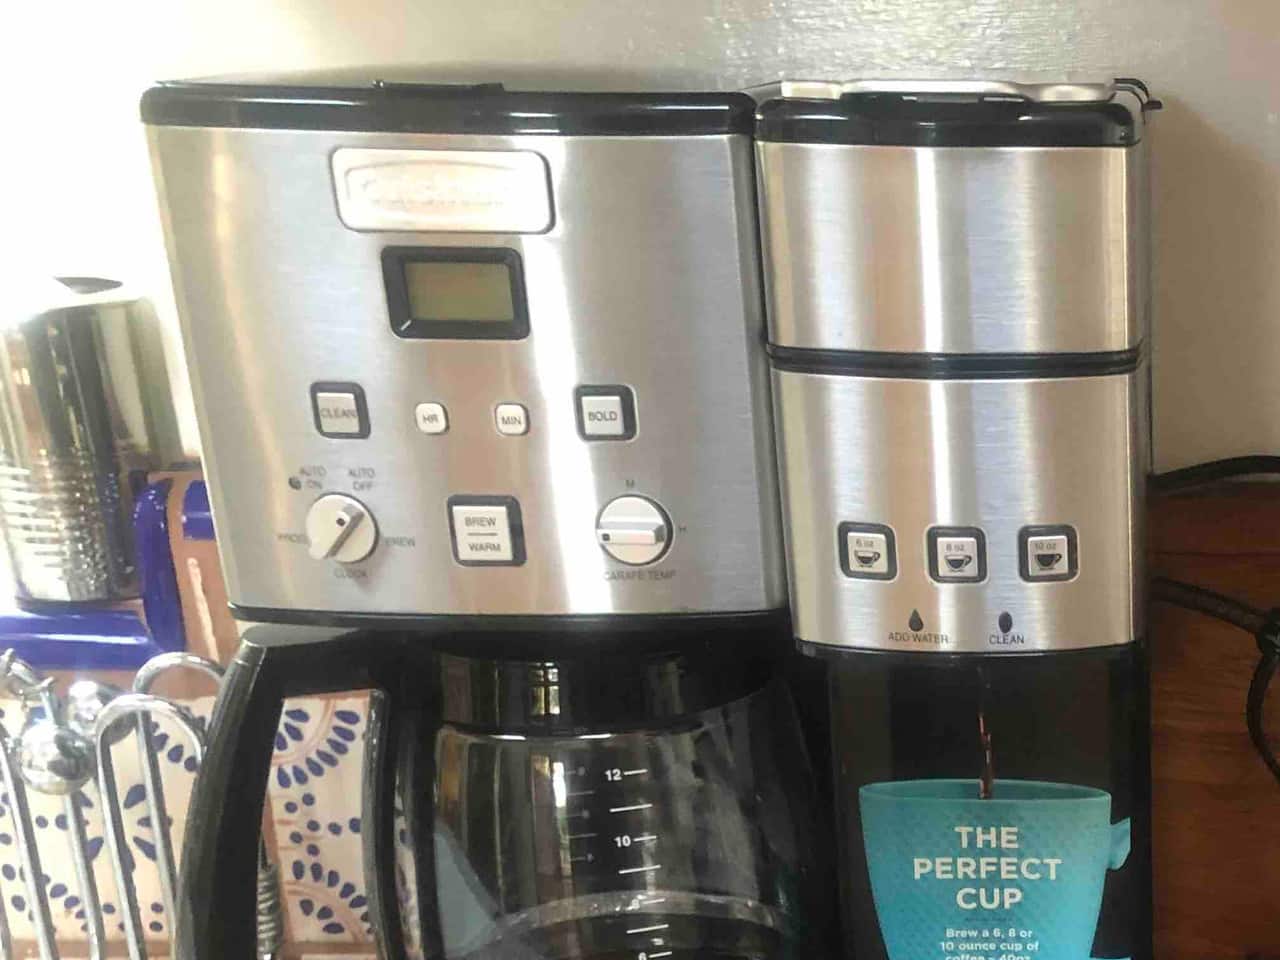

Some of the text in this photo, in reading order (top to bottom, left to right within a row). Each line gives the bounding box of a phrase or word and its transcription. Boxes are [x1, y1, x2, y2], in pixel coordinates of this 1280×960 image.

[422, 413, 439, 424] HR
[501, 415, 522, 426] MIN
[588, 411, 618, 422] BOLD
[465, 516, 497, 527] BREW
[468, 542, 501, 553] WARM
[888, 632, 948, 644] ADD WATER
[989, 634, 1025, 645] CLEAN
[604, 768, 622, 781] 12
[614, 835, 631, 848] 10
[954, 826, 1019, 849] THE
[913, 857, 1062, 881] PERFECT
[956, 887, 1023, 910] CUP
[945, 928, 978, 938] Brew
[993, 928, 1004, 940] 6,
[1008, 928, 1016, 938] 8
[1019, 930, 1033, 938] or
[940, 941, 1040, 954] 10 ounce cup of
